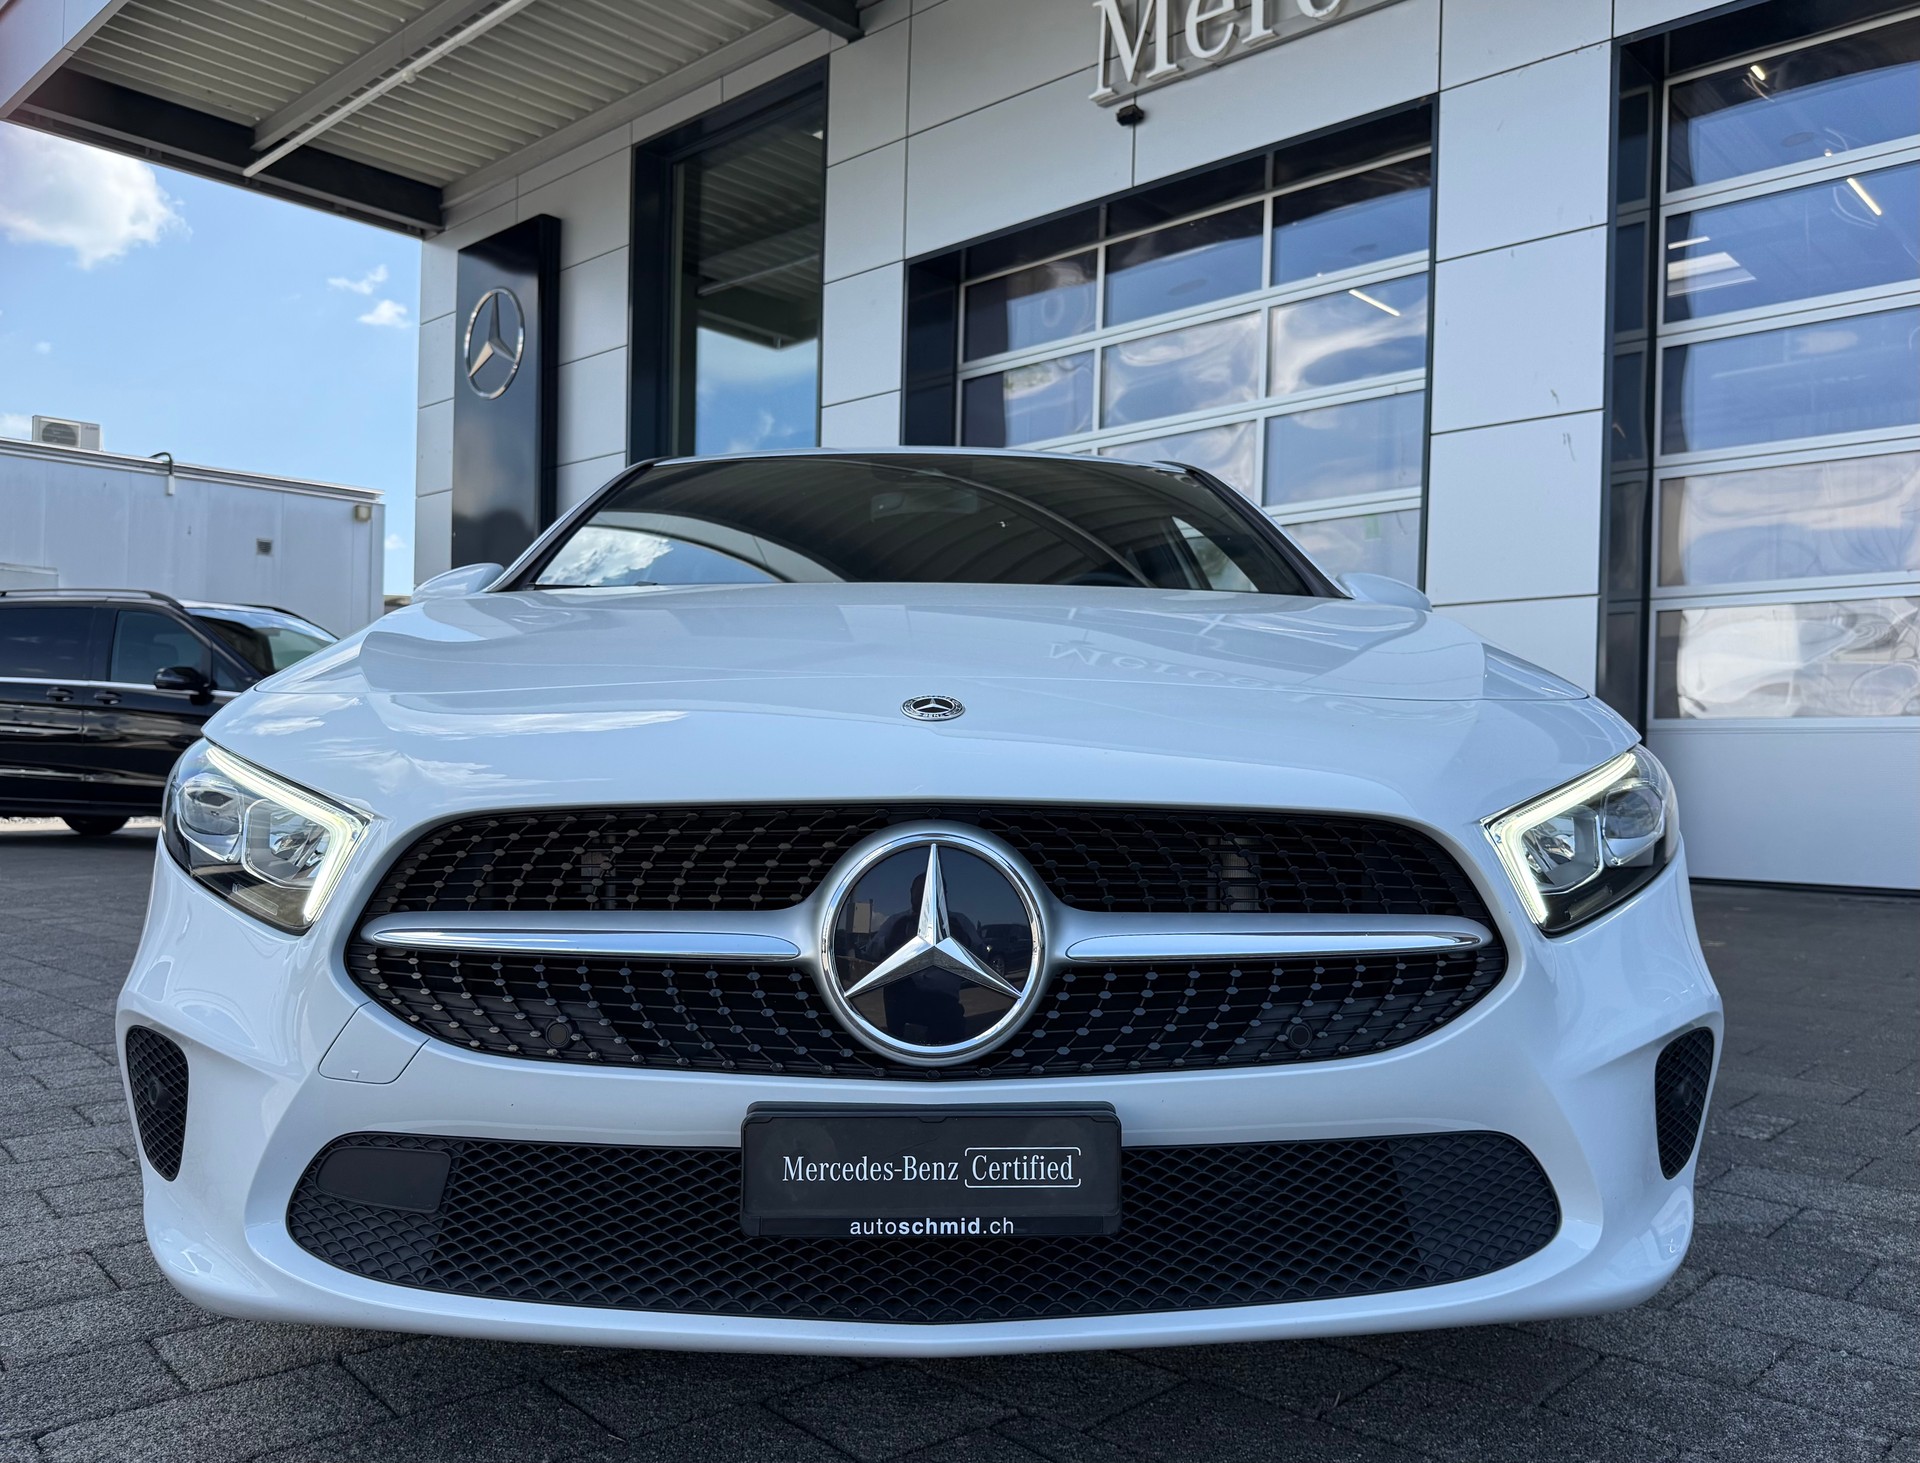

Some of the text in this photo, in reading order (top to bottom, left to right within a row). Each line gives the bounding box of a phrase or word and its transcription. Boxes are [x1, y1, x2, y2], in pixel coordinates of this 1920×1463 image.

[1088, 0, 1341, 99] Mer
[782, 1154, 1074, 1182] Mercedes-Benz Certified
[849, 1217, 1015, 1235] autoschmid.ch
